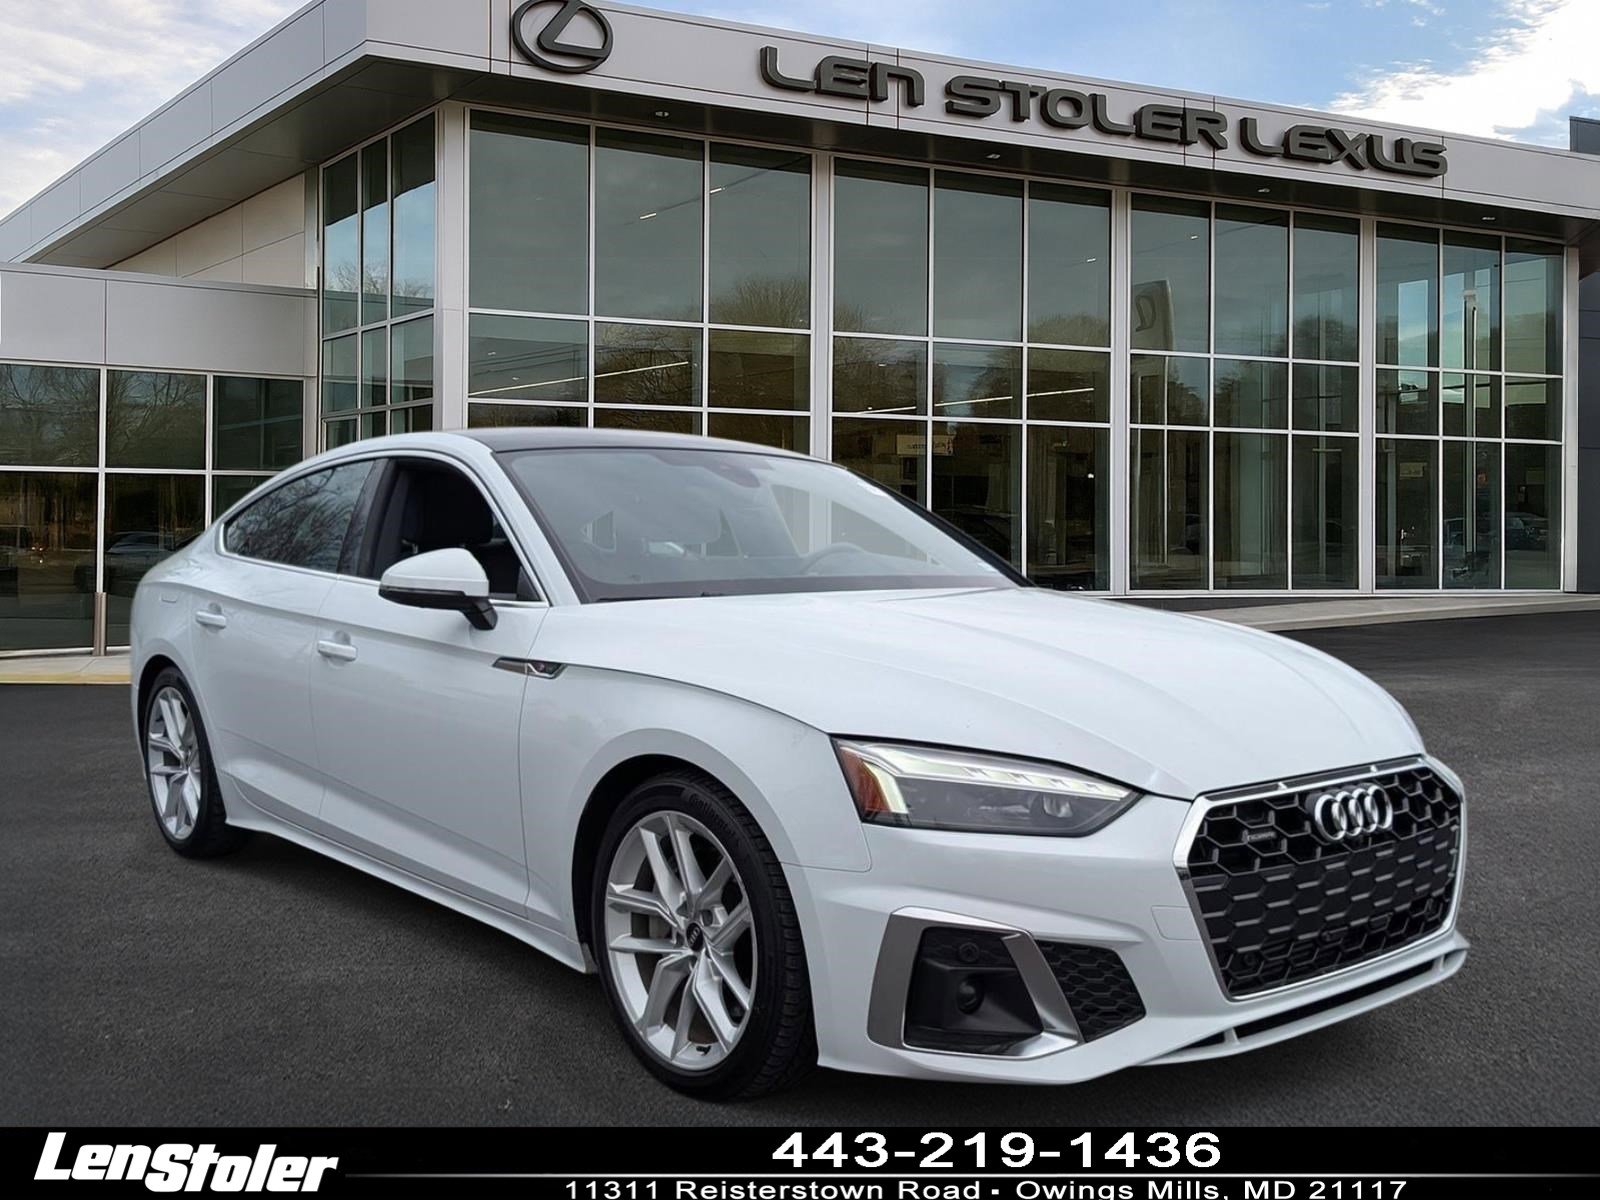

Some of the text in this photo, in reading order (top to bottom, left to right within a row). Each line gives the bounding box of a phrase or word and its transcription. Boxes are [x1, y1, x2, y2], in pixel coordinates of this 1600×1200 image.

[759, 45, 1448, 177] LEN STOLER LEXUS
